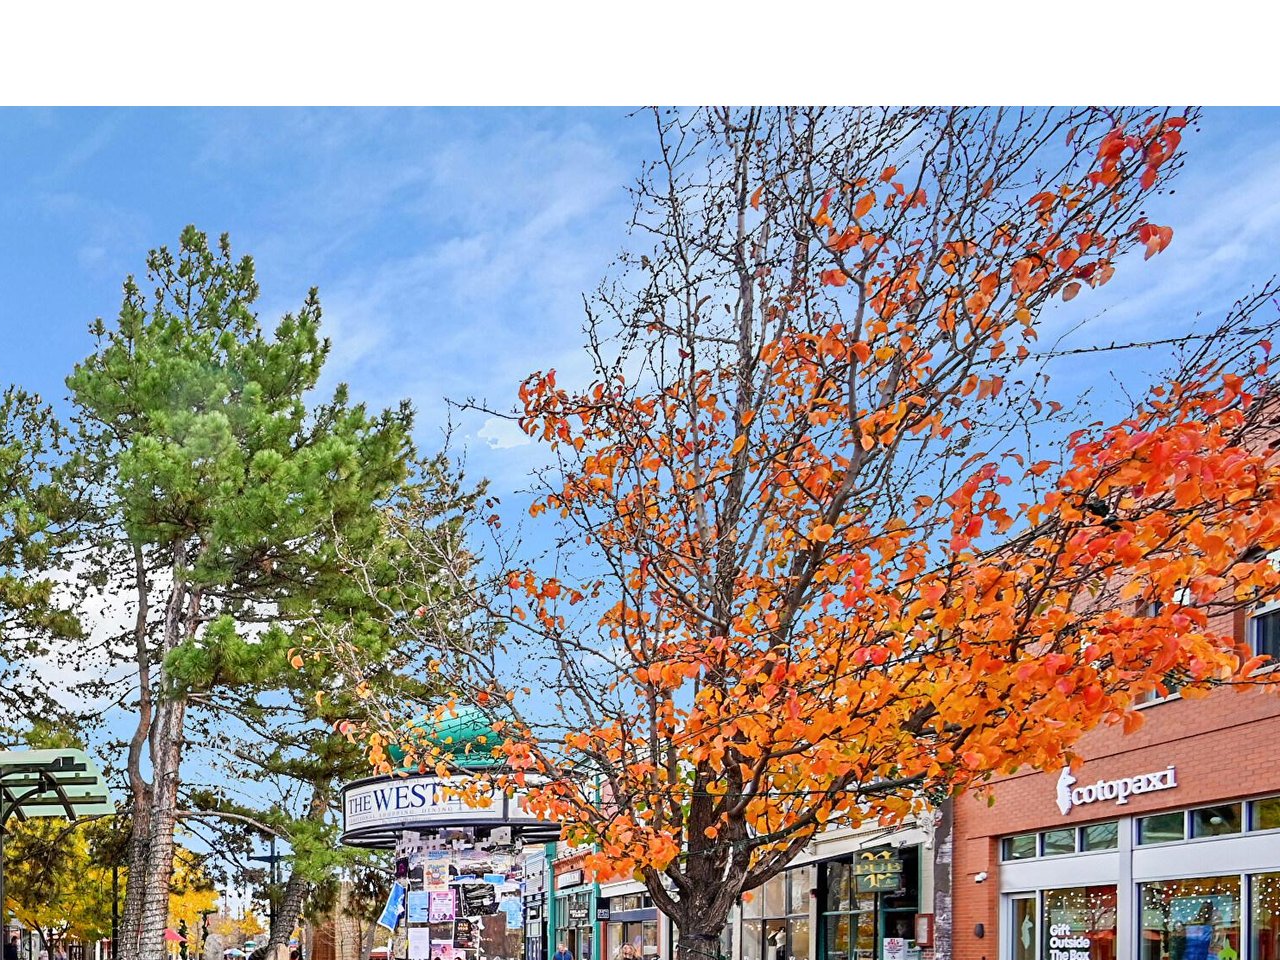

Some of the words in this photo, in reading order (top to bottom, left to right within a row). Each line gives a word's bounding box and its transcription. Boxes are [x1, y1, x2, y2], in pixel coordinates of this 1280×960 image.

[1071, 765, 1178, 805] cotopaxi
[348, 794, 372, 815] THE
[373, 782, 438, 811] WEST
[856, 862, 903, 874] PUB
[1049, 923, 1070, 936] Gift
[1049, 936, 1090, 949] Outside
[1049, 949, 1069, 960] The
[1070, 949, 1090, 960] Box
